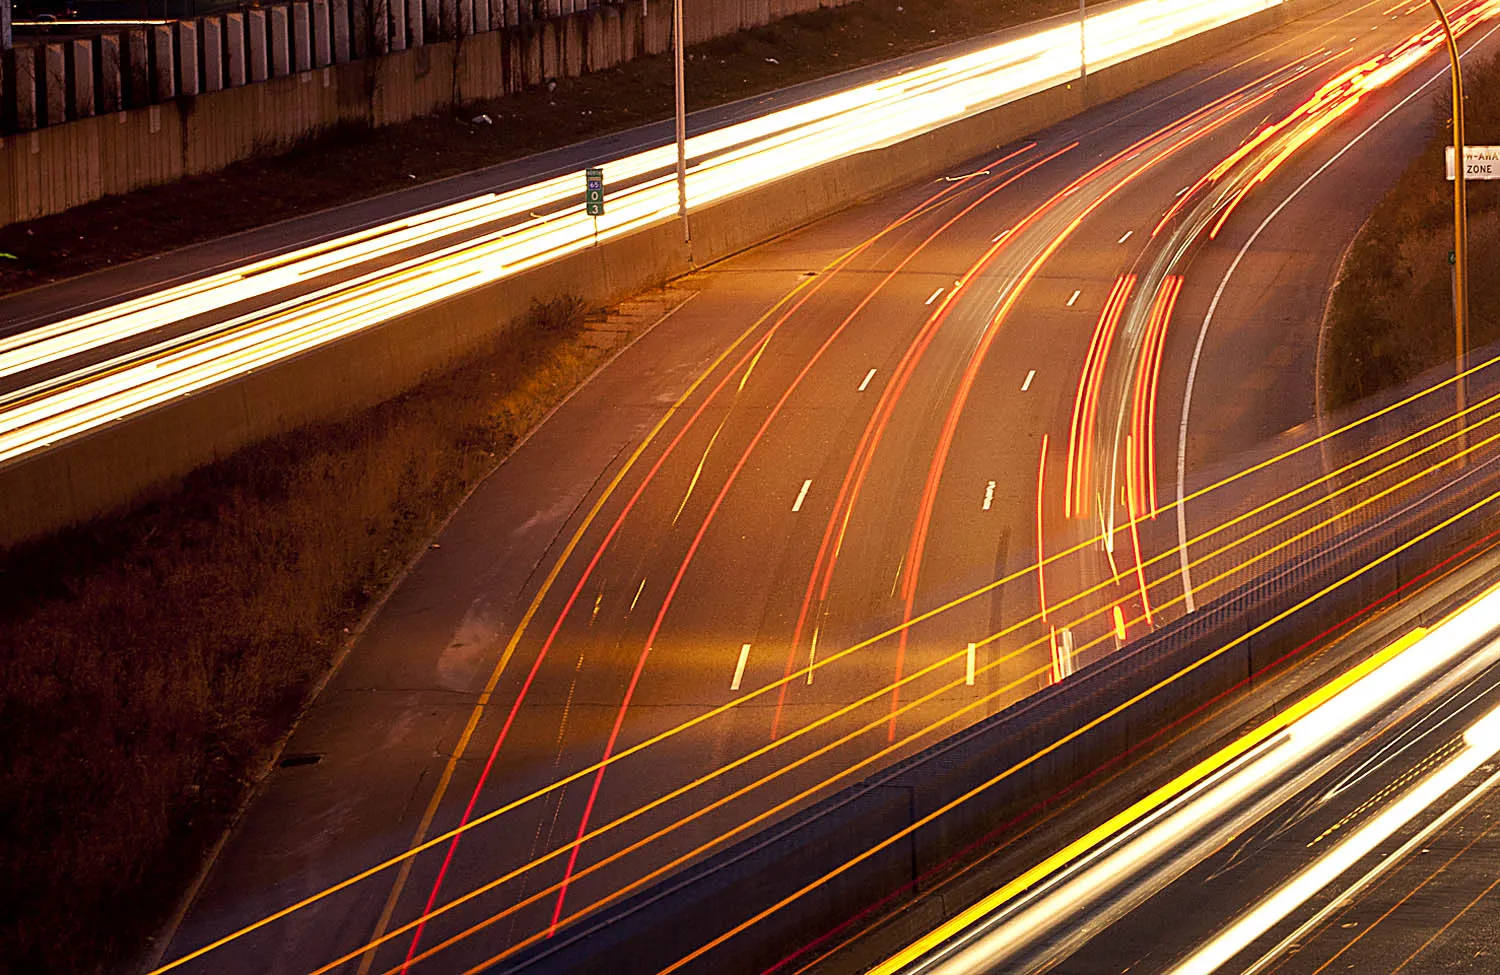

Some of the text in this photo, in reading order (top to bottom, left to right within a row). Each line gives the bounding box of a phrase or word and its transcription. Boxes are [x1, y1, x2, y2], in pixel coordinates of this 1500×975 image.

[1466, 165, 1493, 174] ZONE
[591, 191, 599, 201] 0
[592, 205, 599, 214] 3
